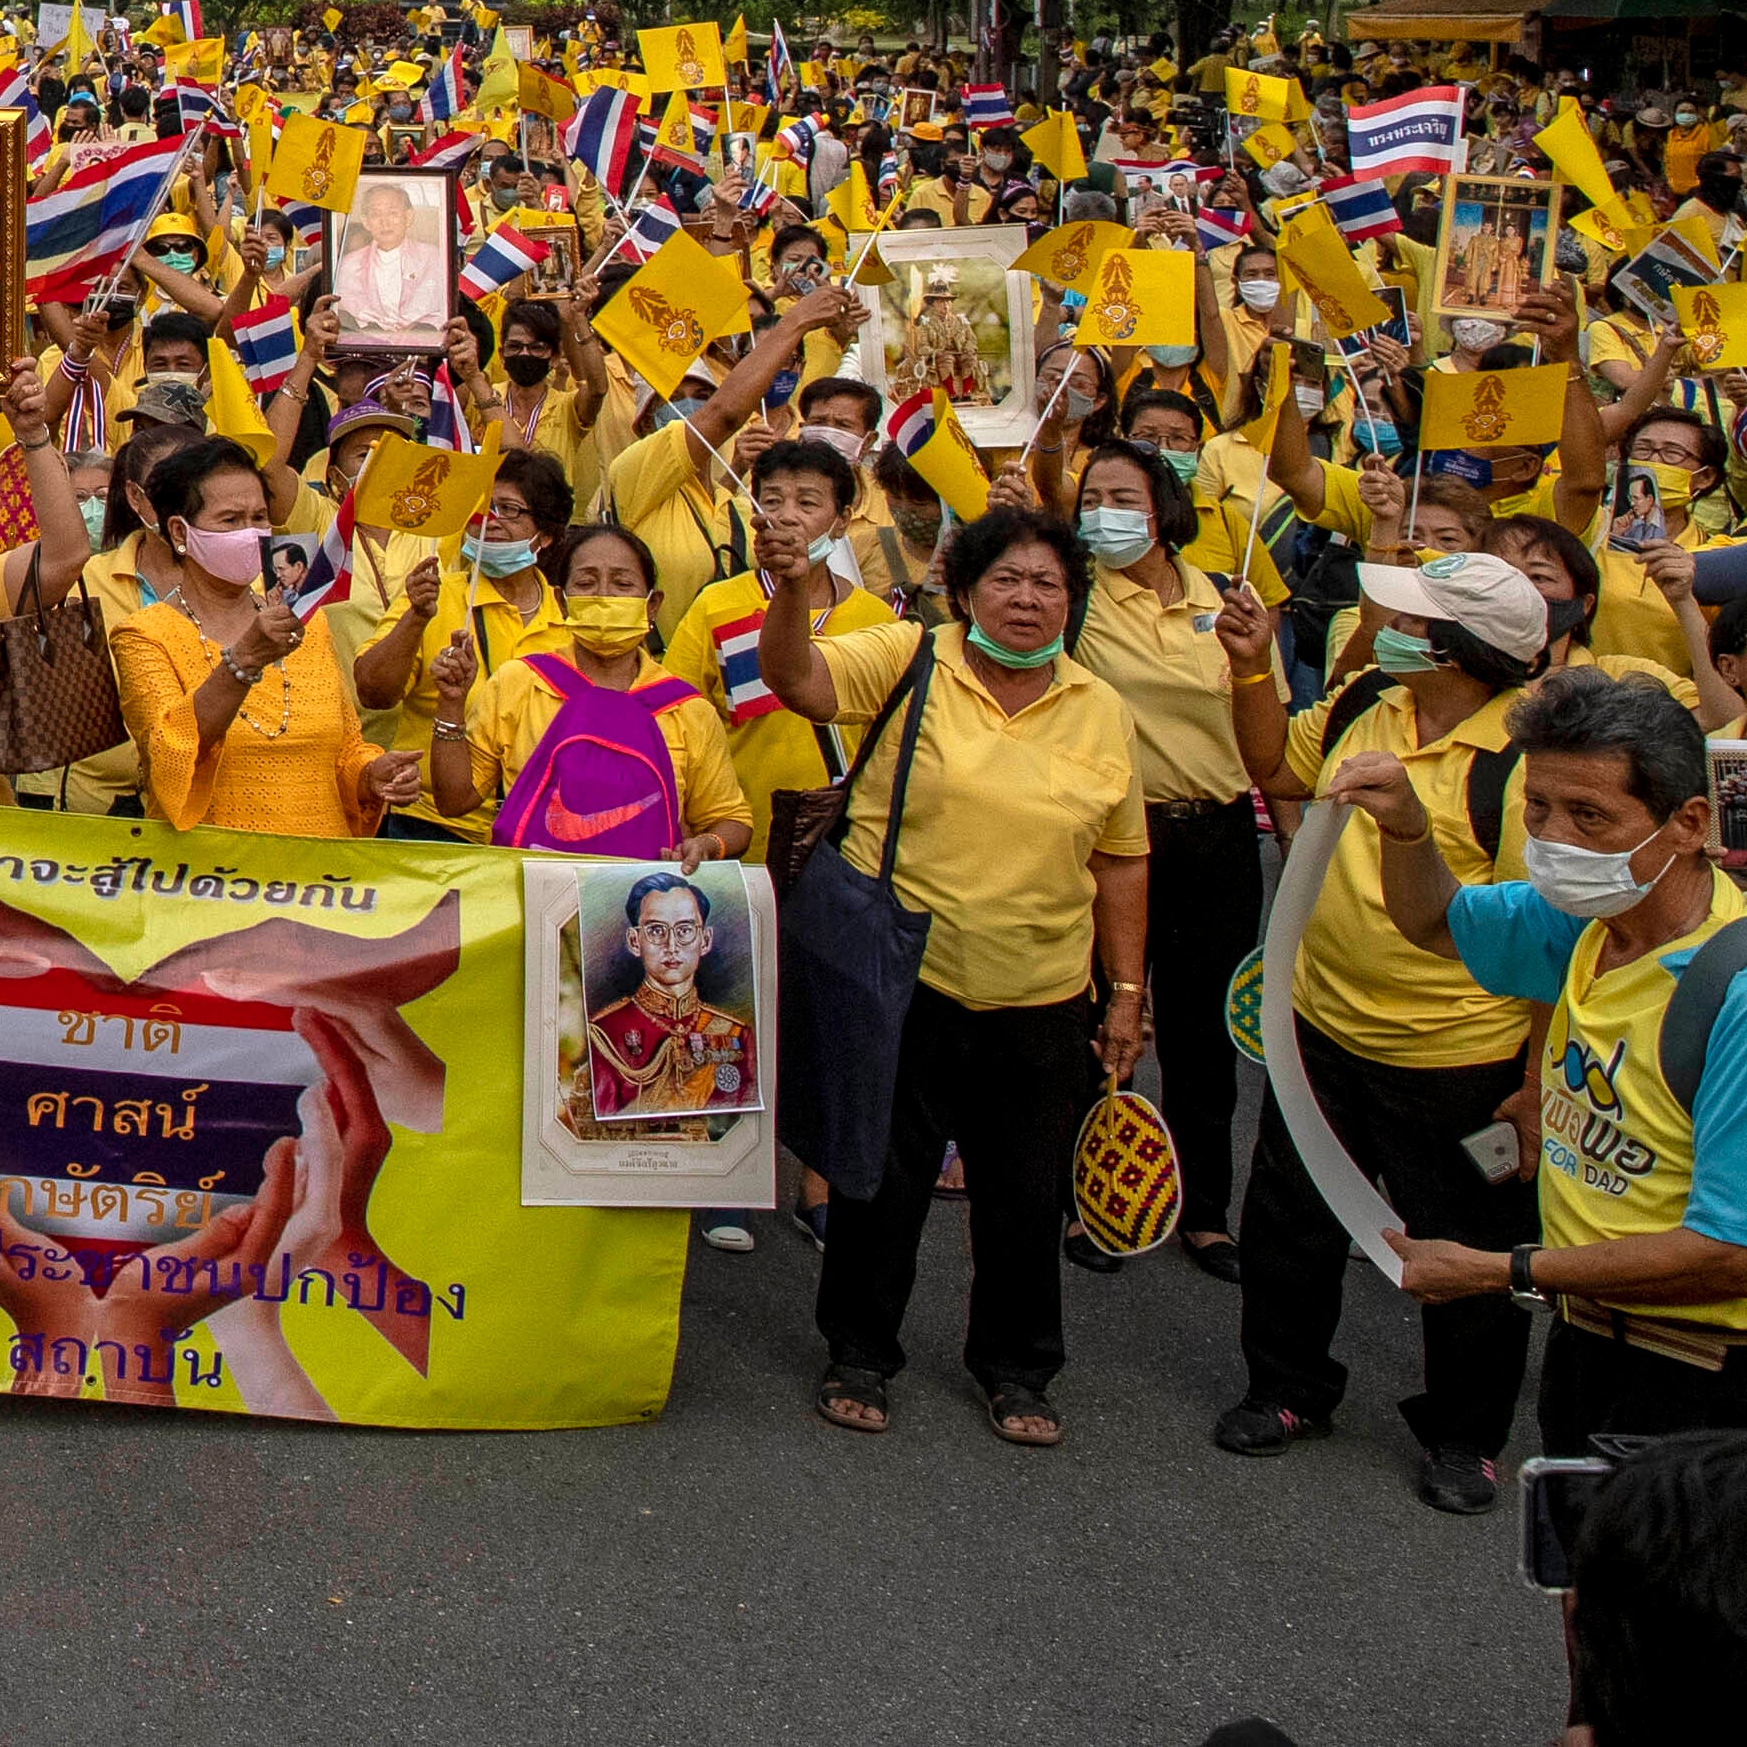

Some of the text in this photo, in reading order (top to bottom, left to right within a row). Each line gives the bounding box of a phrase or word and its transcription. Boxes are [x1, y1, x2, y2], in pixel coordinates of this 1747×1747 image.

[57, 1002, 183, 1054] ชาติ
[26, 1083, 210, 1141] ศาสน์
[1584, 1163, 1629, 1196] DAD
[8, 1325, 223, 1388] สถาบัน
